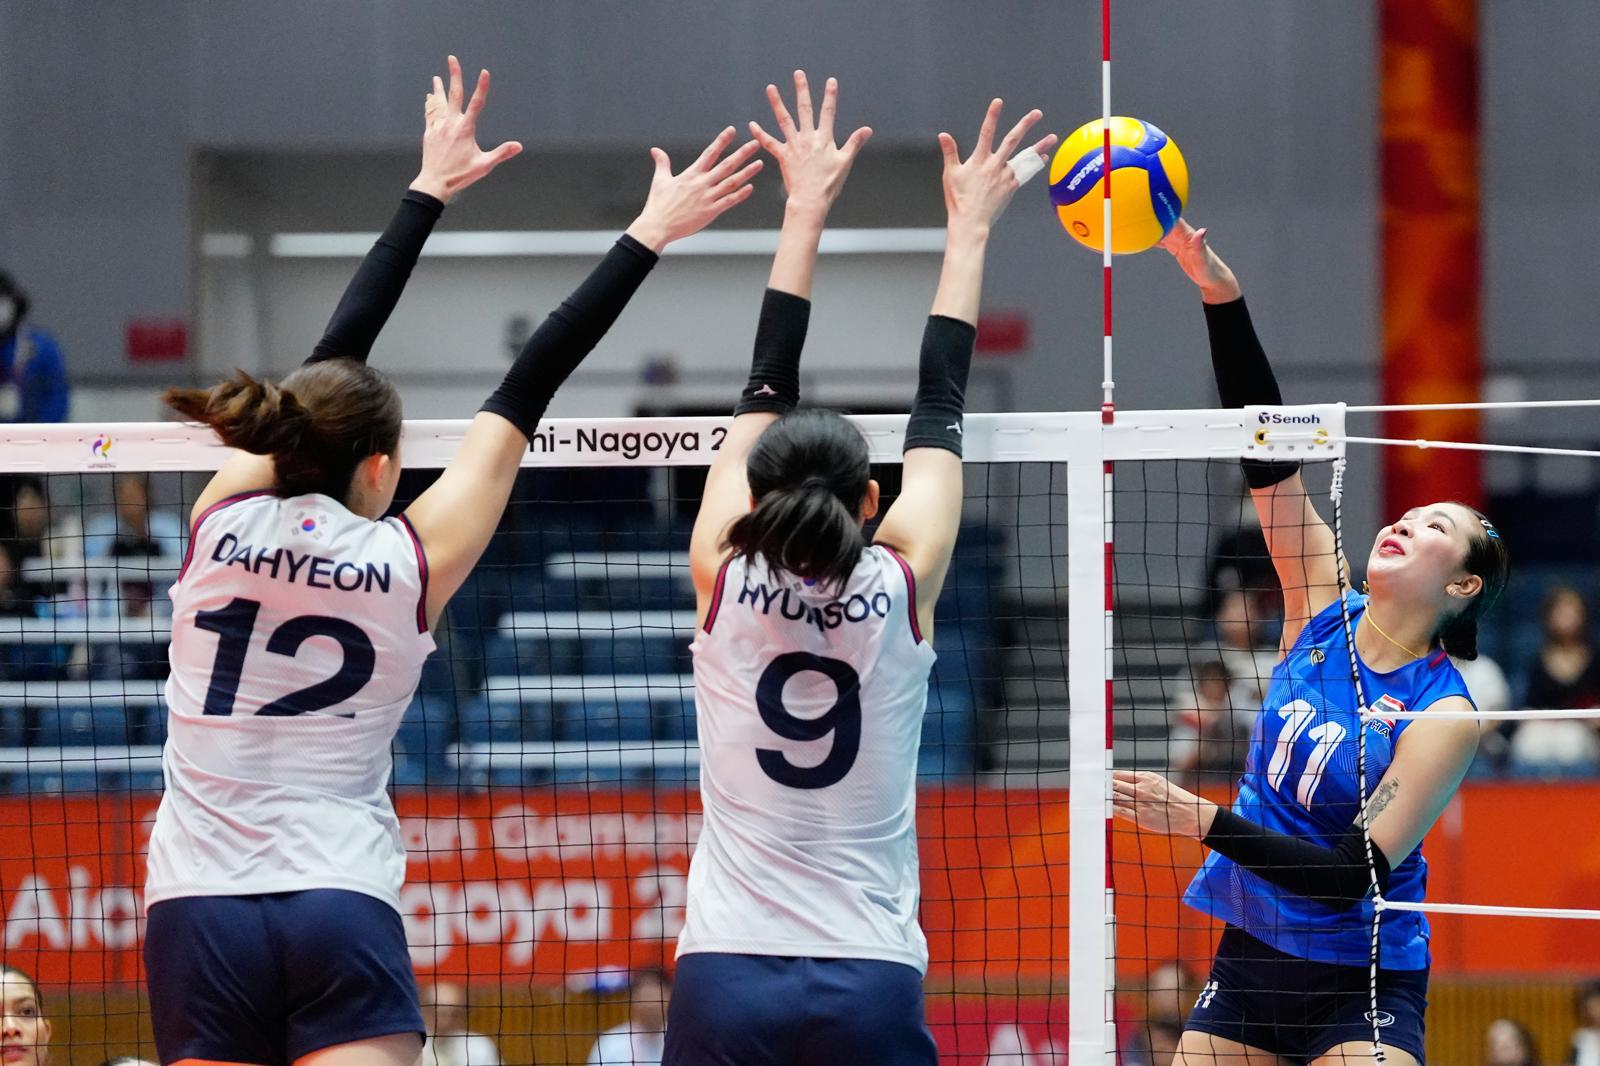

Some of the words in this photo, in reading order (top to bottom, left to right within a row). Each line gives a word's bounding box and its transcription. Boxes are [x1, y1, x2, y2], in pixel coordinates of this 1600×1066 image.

[1272, 414, 1320, 424] Senoh
[211, 533, 390, 593] DAHYEON
[195, 597, 376, 719] 12
[756, 652, 862, 789] 9
[1267, 699, 1347, 812] 11
